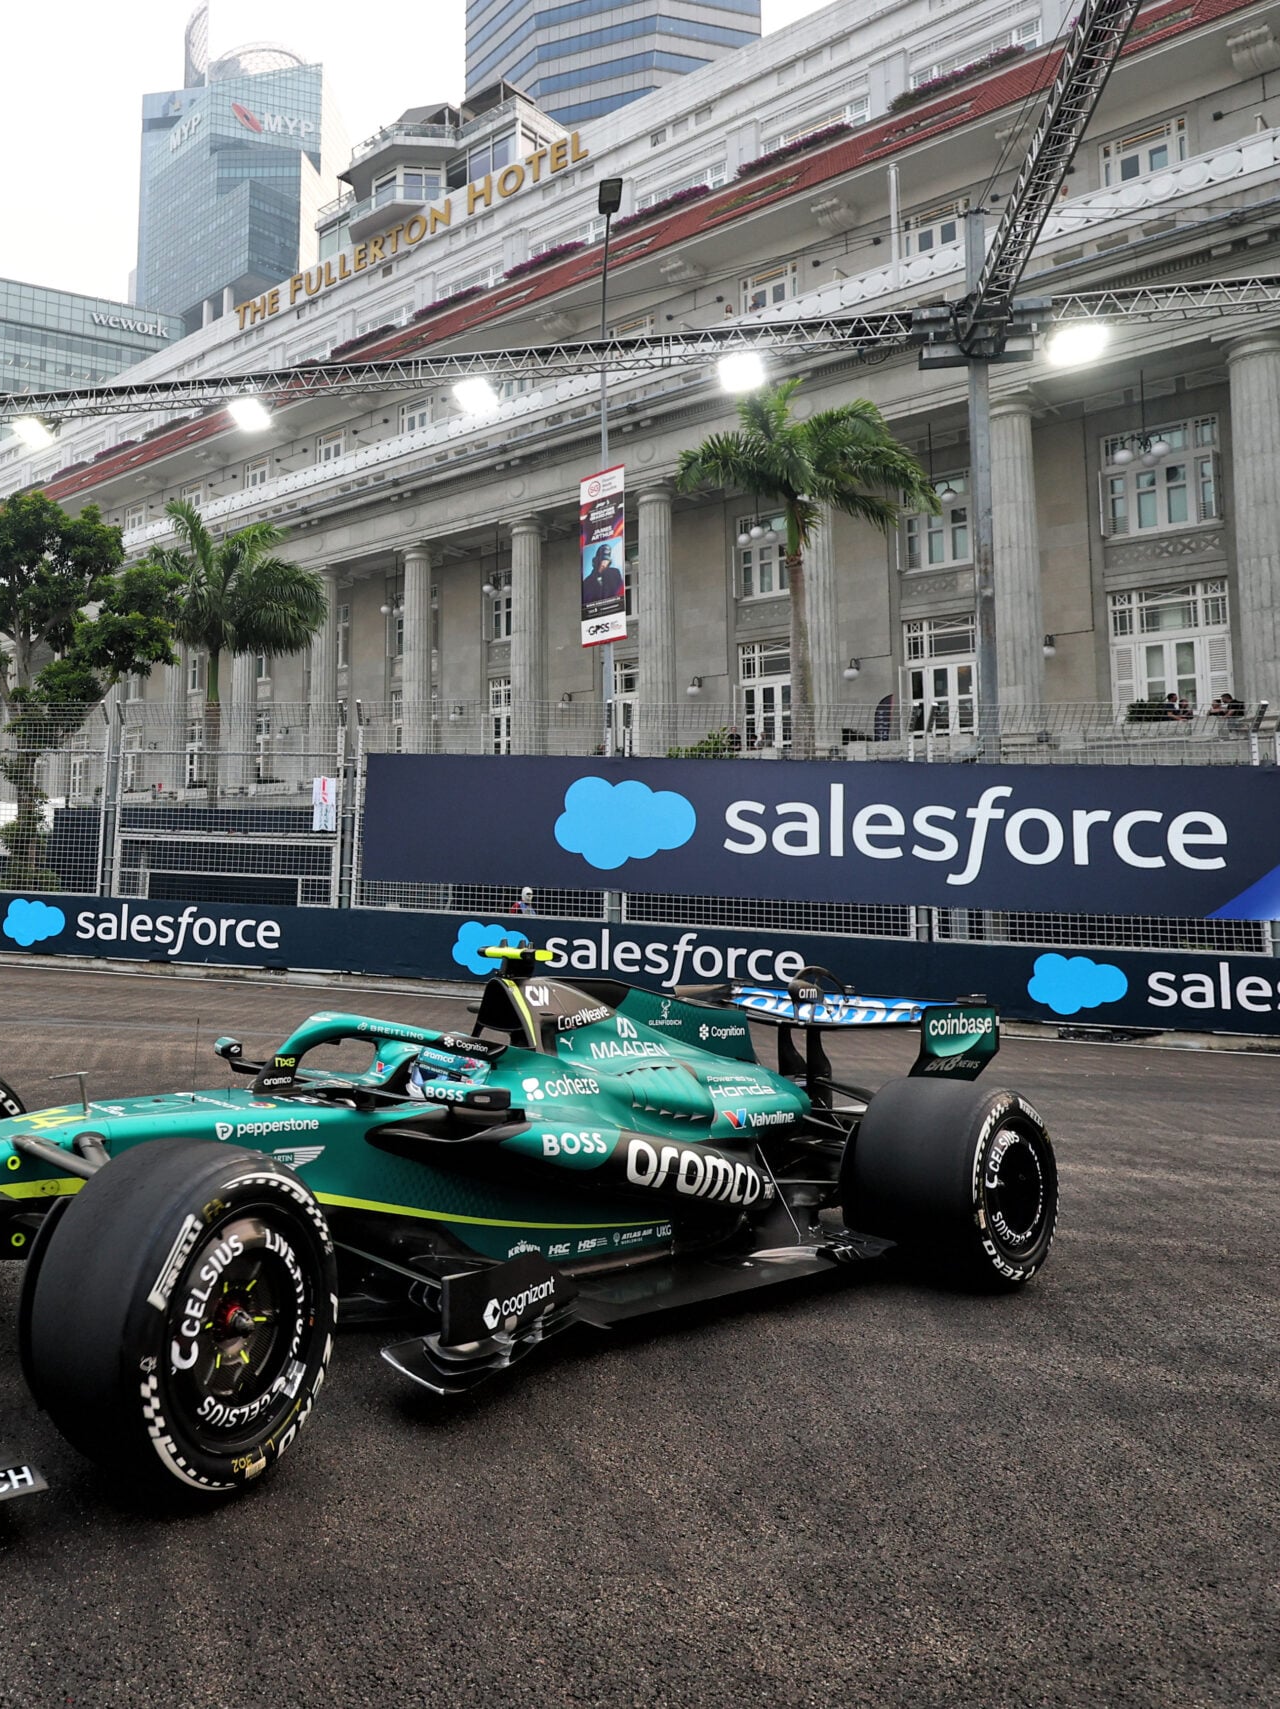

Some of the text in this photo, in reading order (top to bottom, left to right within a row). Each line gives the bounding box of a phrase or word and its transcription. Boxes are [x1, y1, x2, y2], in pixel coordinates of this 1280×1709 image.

[171, 113, 202, 150] MYP
[263, 112, 315, 138] MYP
[234, 131, 589, 330] THE FULLERTON HOTEL
[91, 311, 171, 338] wework
[723, 783, 1228, 886] salesforce
[75, 903, 281, 955] salesforce
[544, 928, 806, 987] salesforce
[798, 987, 818, 999] arm
[1147, 961, 1280, 1012] sale
[557, 1005, 611, 1031] CoreWeave
[929, 1012, 993, 1036] coinbase
[370, 1024, 425, 1042] BREITLING
[710, 1025, 746, 1039] Cognition
[423, 1050, 455, 1064] aramco
[455, 1038, 489, 1054] Cognition
[590, 1041, 671, 1060] MAADEN
[263, 1076, 292, 1086] aramco
[544, 1074, 600, 1096] cohere
[708, 1083, 777, 1099] Honda
[425, 1086, 465, 1103] BOSS
[236, 1118, 319, 1138] pepperstone
[748, 1111, 795, 1127] Valvoline
[541, 1132, 608, 1156] BOSS
[989, 1130, 1020, 1173] CELSIUS
[273, 1154, 293, 1162] ARTIN
[626, 1139, 761, 1205] aramco
[621, 1230, 641, 1240] ATLAS
[656, 1225, 672, 1238] UKG
[147, 1213, 204, 1312] PIRELLI
[982, 1240, 1025, 1281] ZERO
[181, 1234, 244, 1338] CELSIUS
[502, 1275, 556, 1317] cognizant
